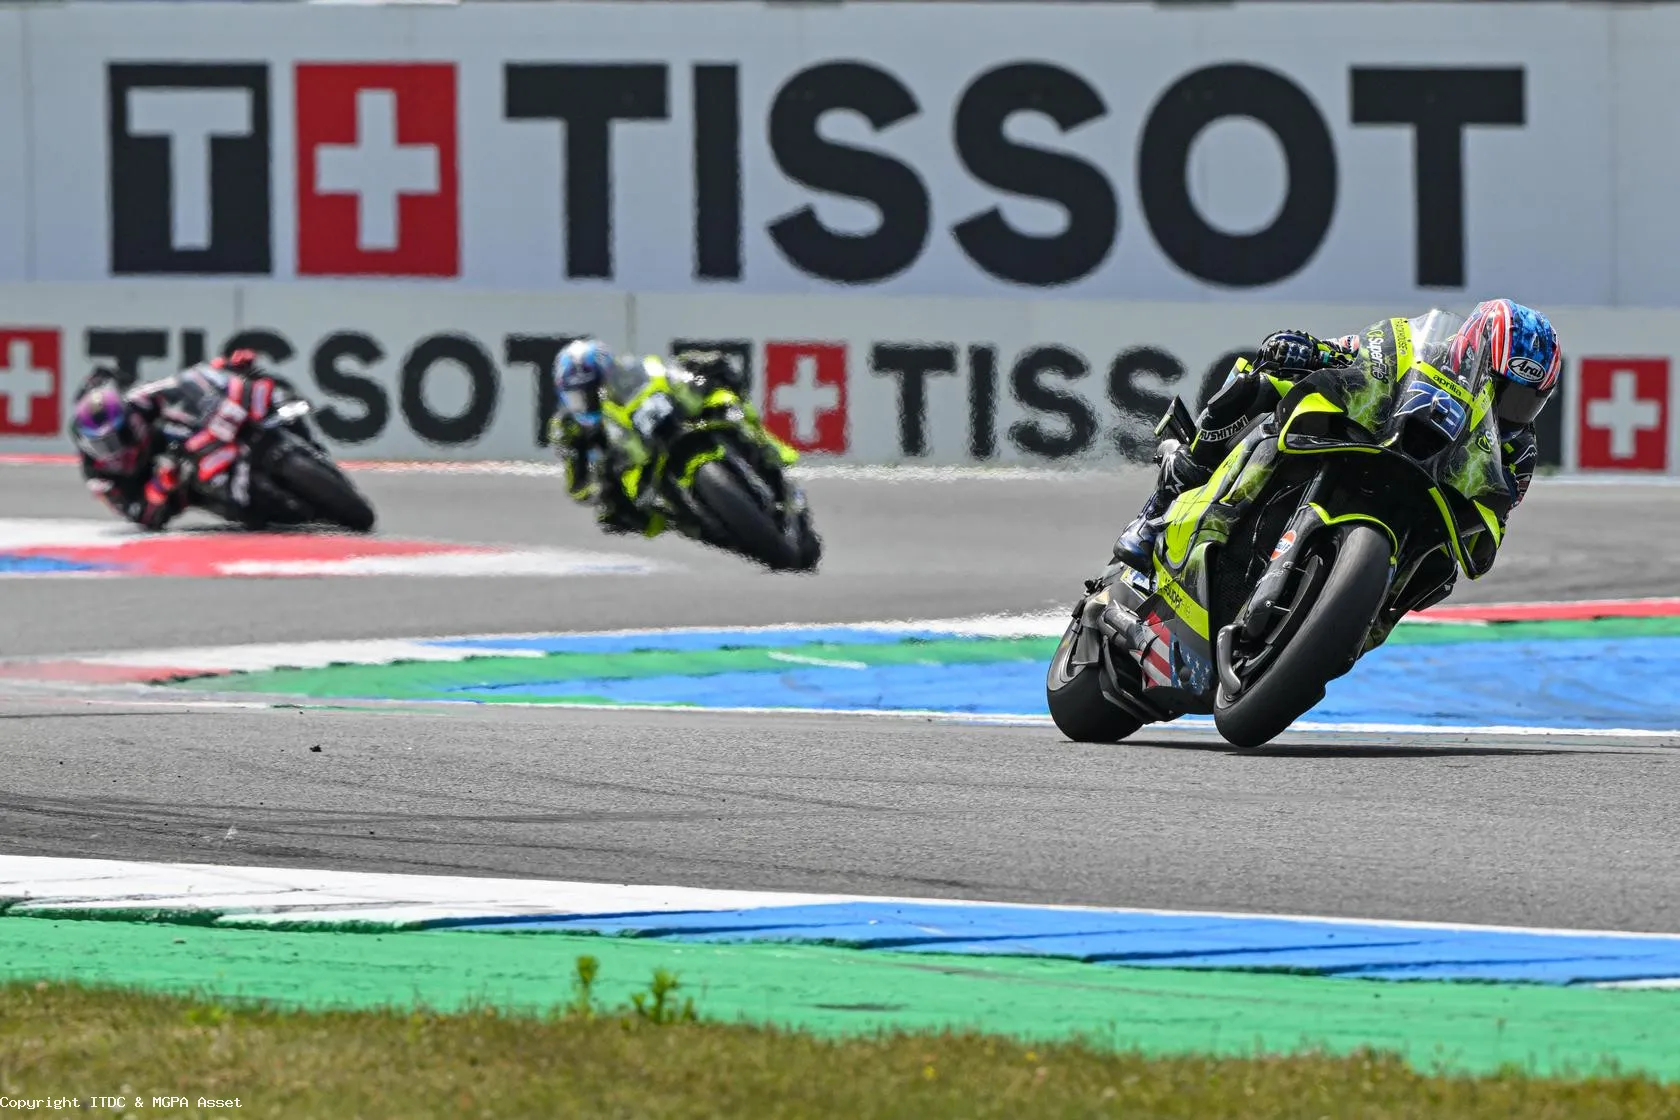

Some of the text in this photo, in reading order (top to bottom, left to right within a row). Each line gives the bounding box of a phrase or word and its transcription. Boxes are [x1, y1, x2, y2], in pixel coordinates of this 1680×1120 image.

[504, 61, 1526, 287] TISSOT
[1511, 360, 1542, 377] Arai
[1433, 374, 1462, 397] aprilia
